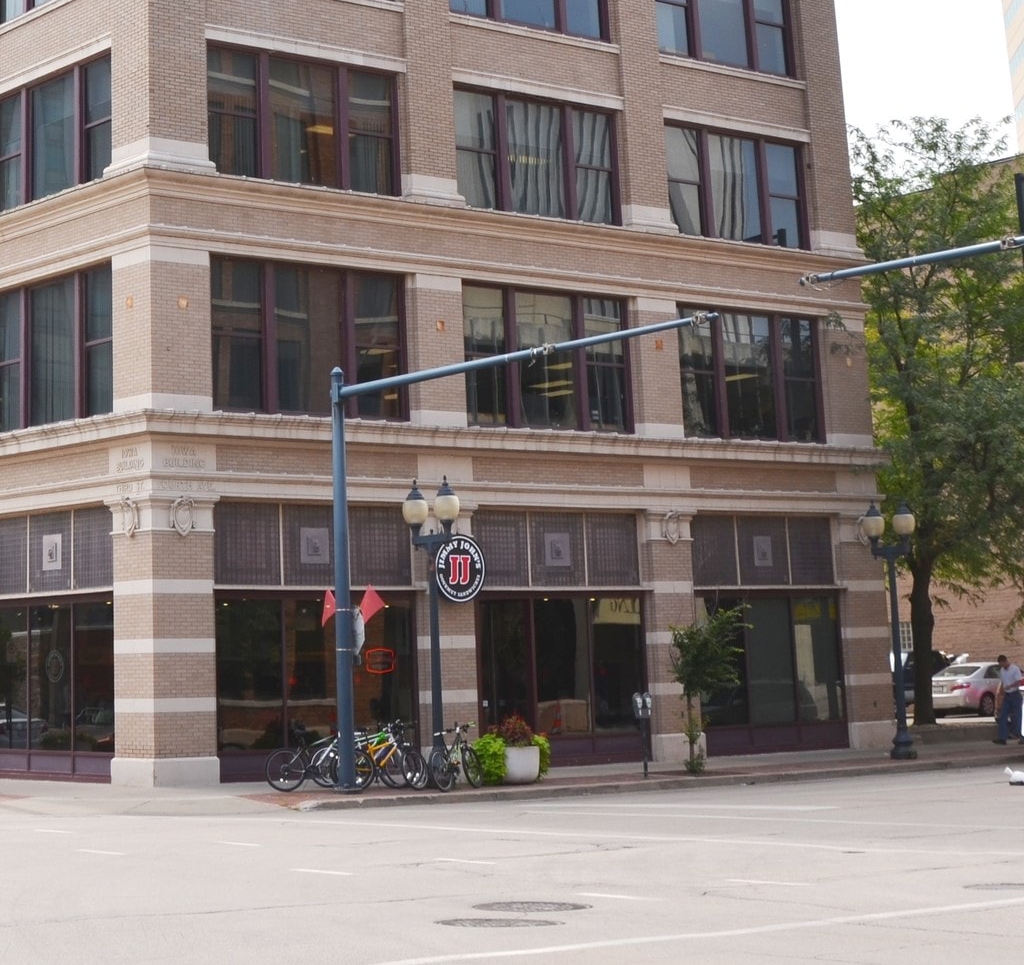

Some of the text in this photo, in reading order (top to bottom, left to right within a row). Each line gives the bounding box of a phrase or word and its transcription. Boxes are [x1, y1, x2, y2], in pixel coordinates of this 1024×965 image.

[122, 446, 138, 458] IOWA
[170, 444, 196, 456] IOWA
[163, 458, 206, 469] BUILDING
[438, 540, 481, 570] JIMMY JOHN'S
[449, 555, 471, 584] JJ
